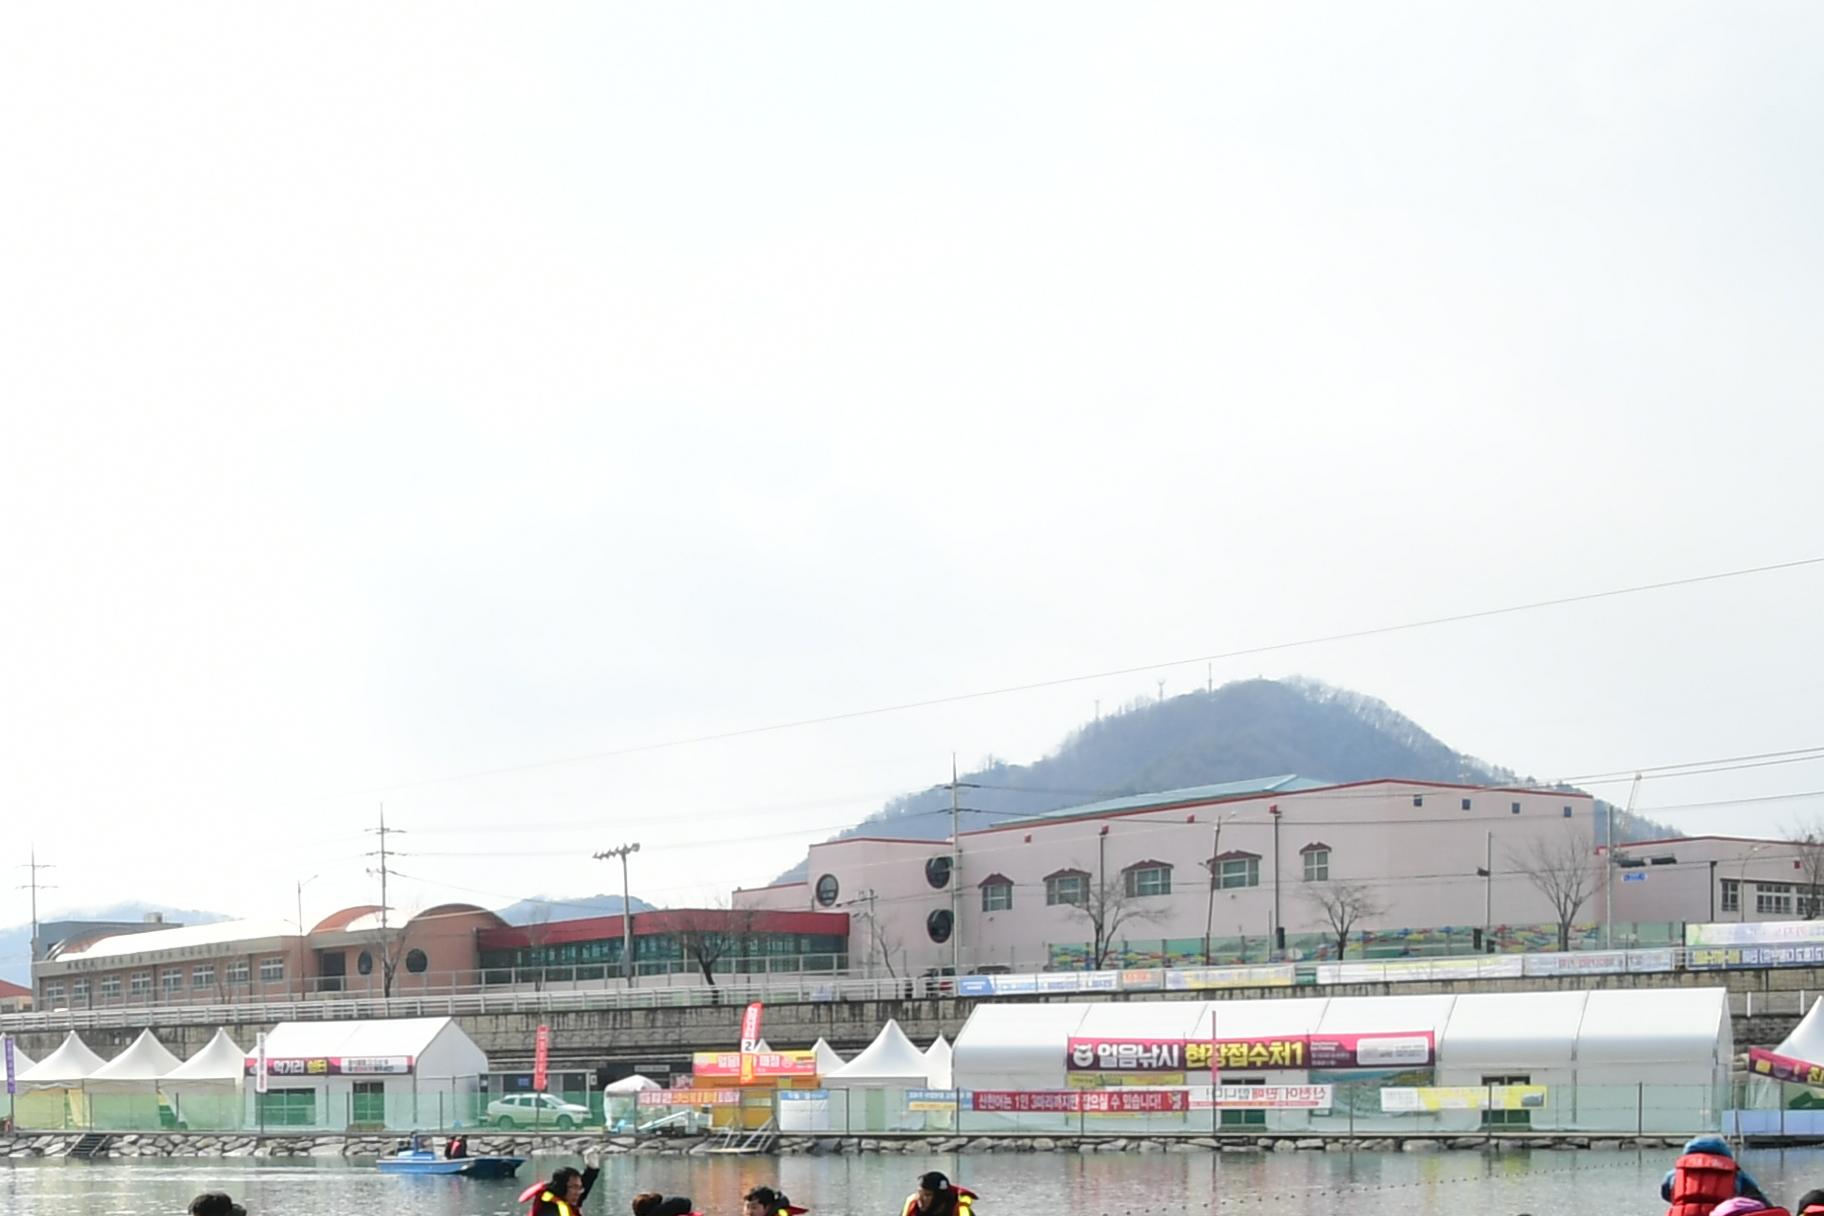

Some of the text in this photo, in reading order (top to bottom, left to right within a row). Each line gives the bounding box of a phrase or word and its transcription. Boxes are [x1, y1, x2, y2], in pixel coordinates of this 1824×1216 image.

[744, 1041, 753, 1051] 2
[1097, 1043, 1179, 1068] 얼음낚시
[1184, 1040, 1303, 1067] 현장접수처1
[274, 1060, 305, 1074] 먹거리
[1110, 1094, 1121, 1110] 수
